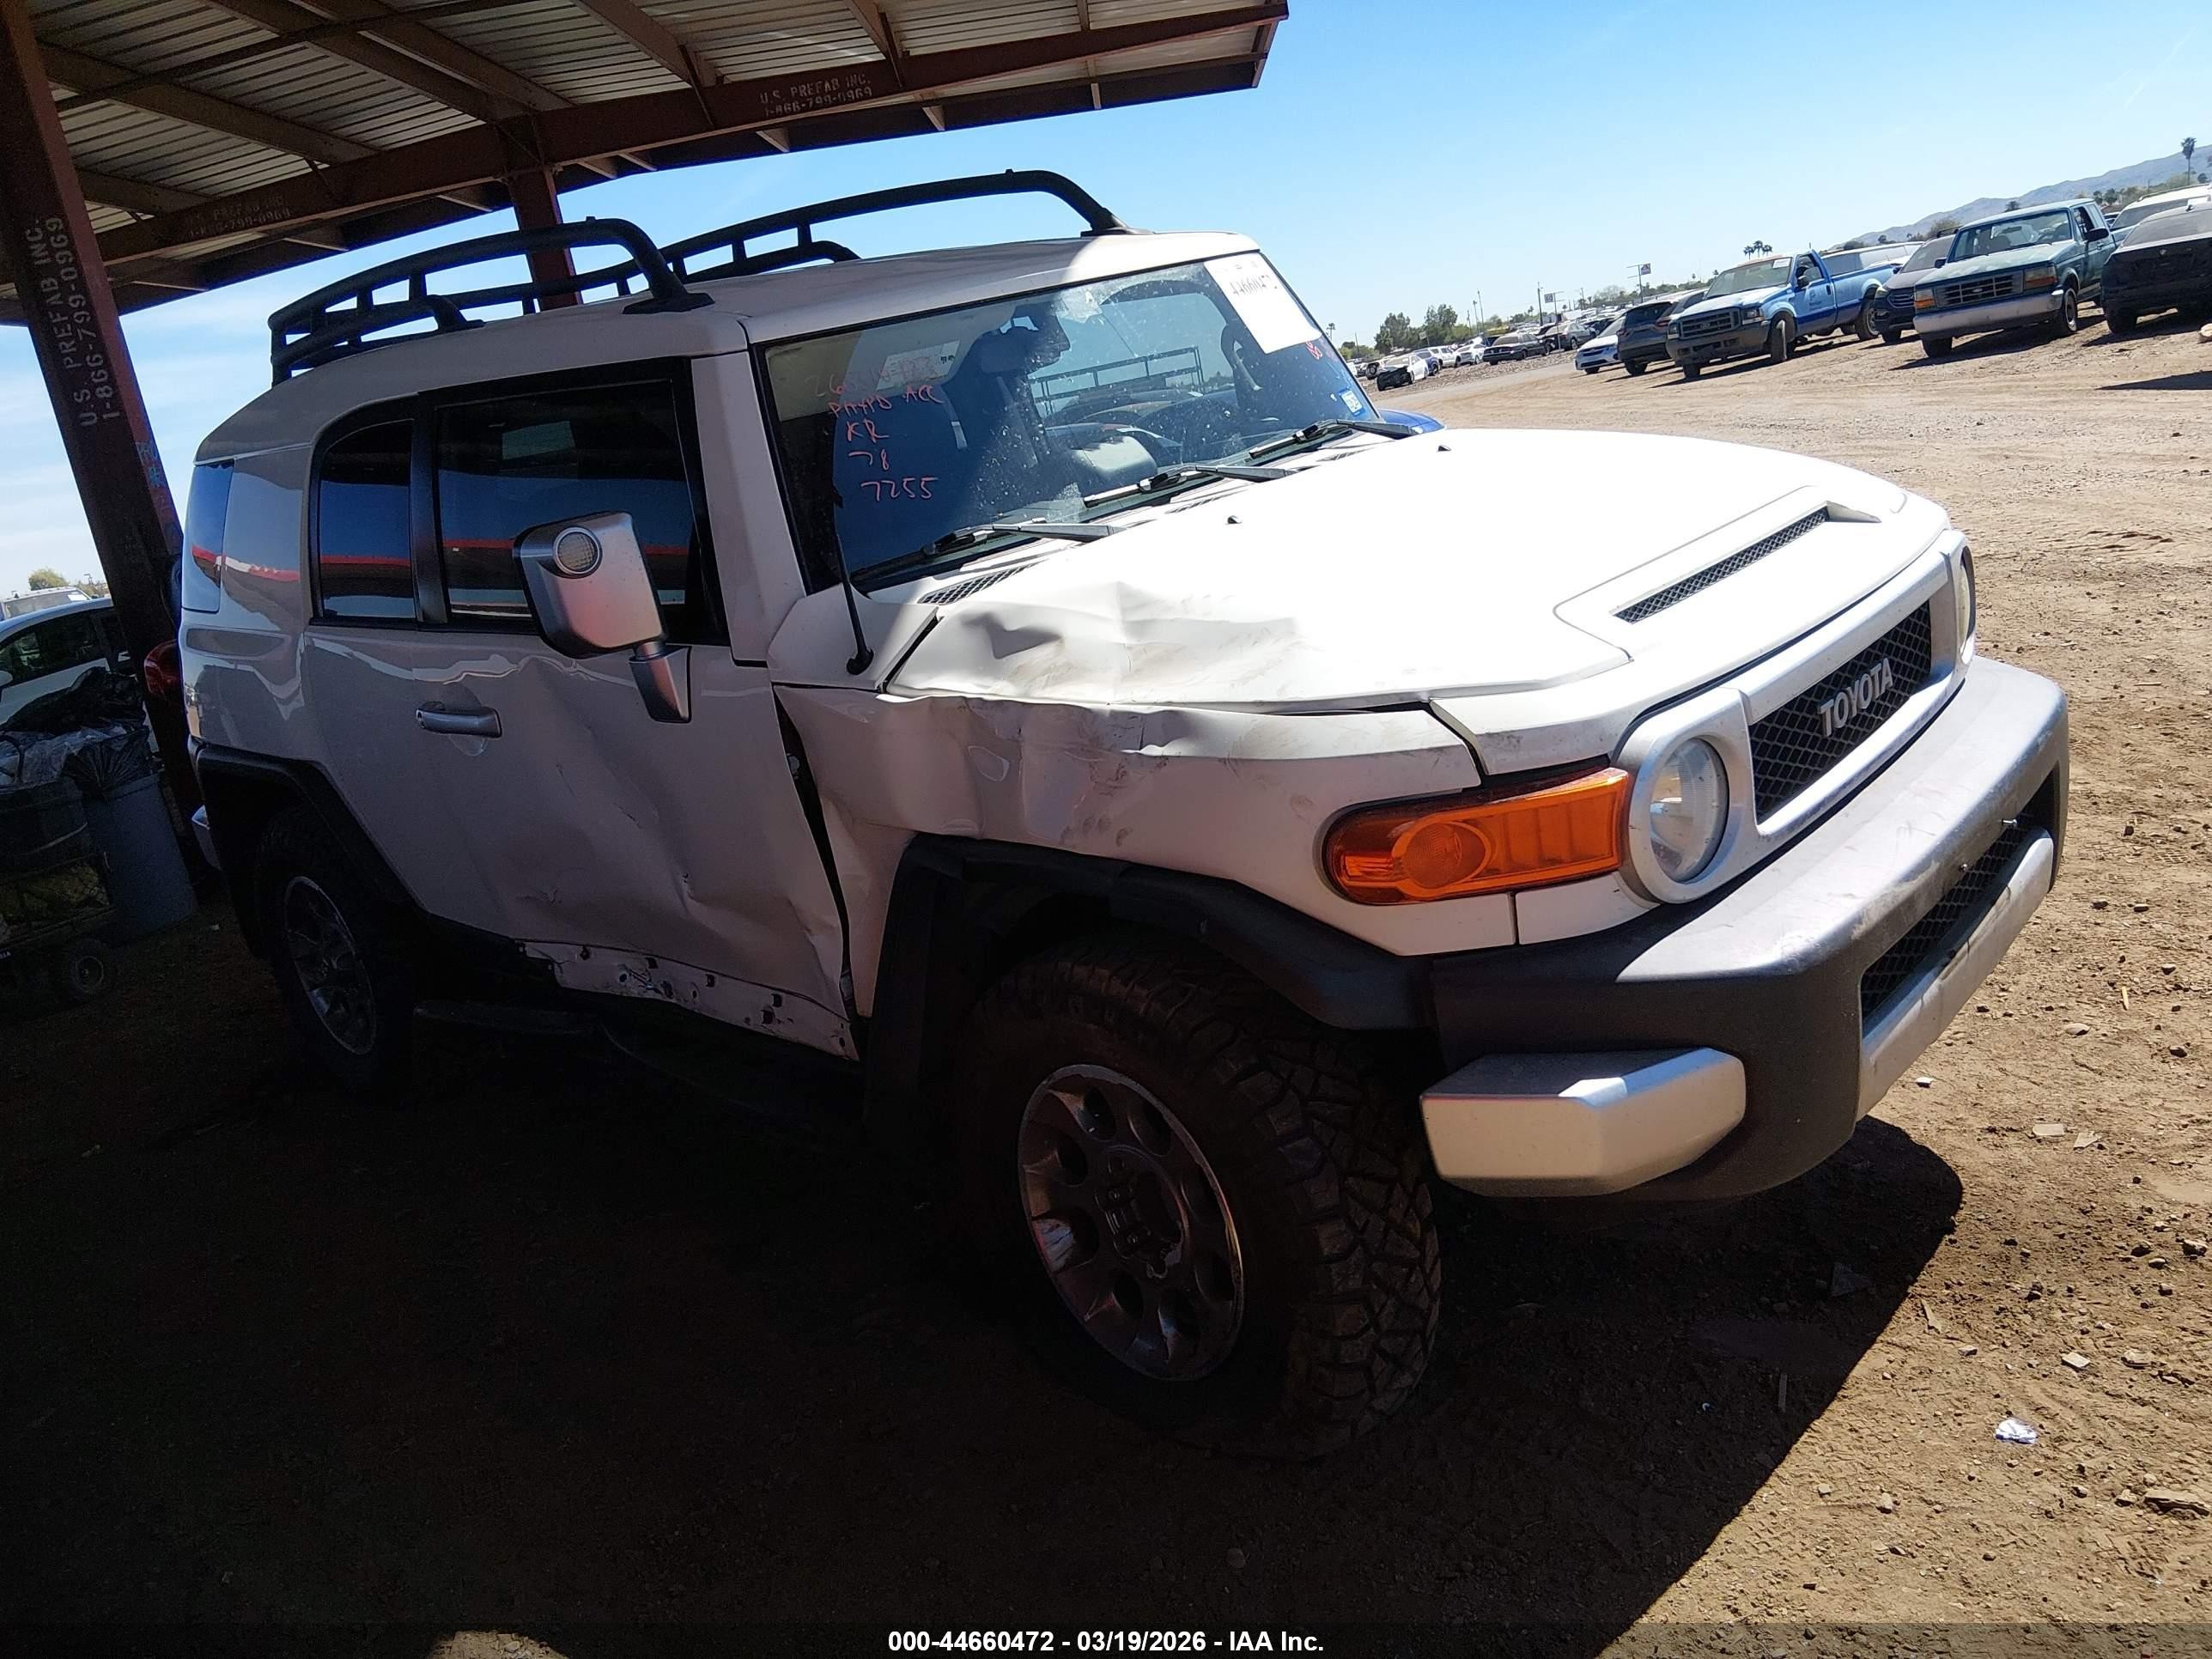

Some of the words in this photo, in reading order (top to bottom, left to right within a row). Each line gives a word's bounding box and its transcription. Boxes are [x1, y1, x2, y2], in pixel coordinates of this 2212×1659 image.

[790, 78, 840, 97] PREFAB
[26, 219, 52, 266] INC.
[40, 276, 82, 369] PREFAB
[46, 217, 120, 420] 1-866-799-0969
[74, 382, 98, 427] U.S.
[847, 418, 890, 443] KR
[848, 449, 890, 471] 78
[860, 477, 939, 501] 7255
[1818, 658, 1893, 737] TOYOTA
